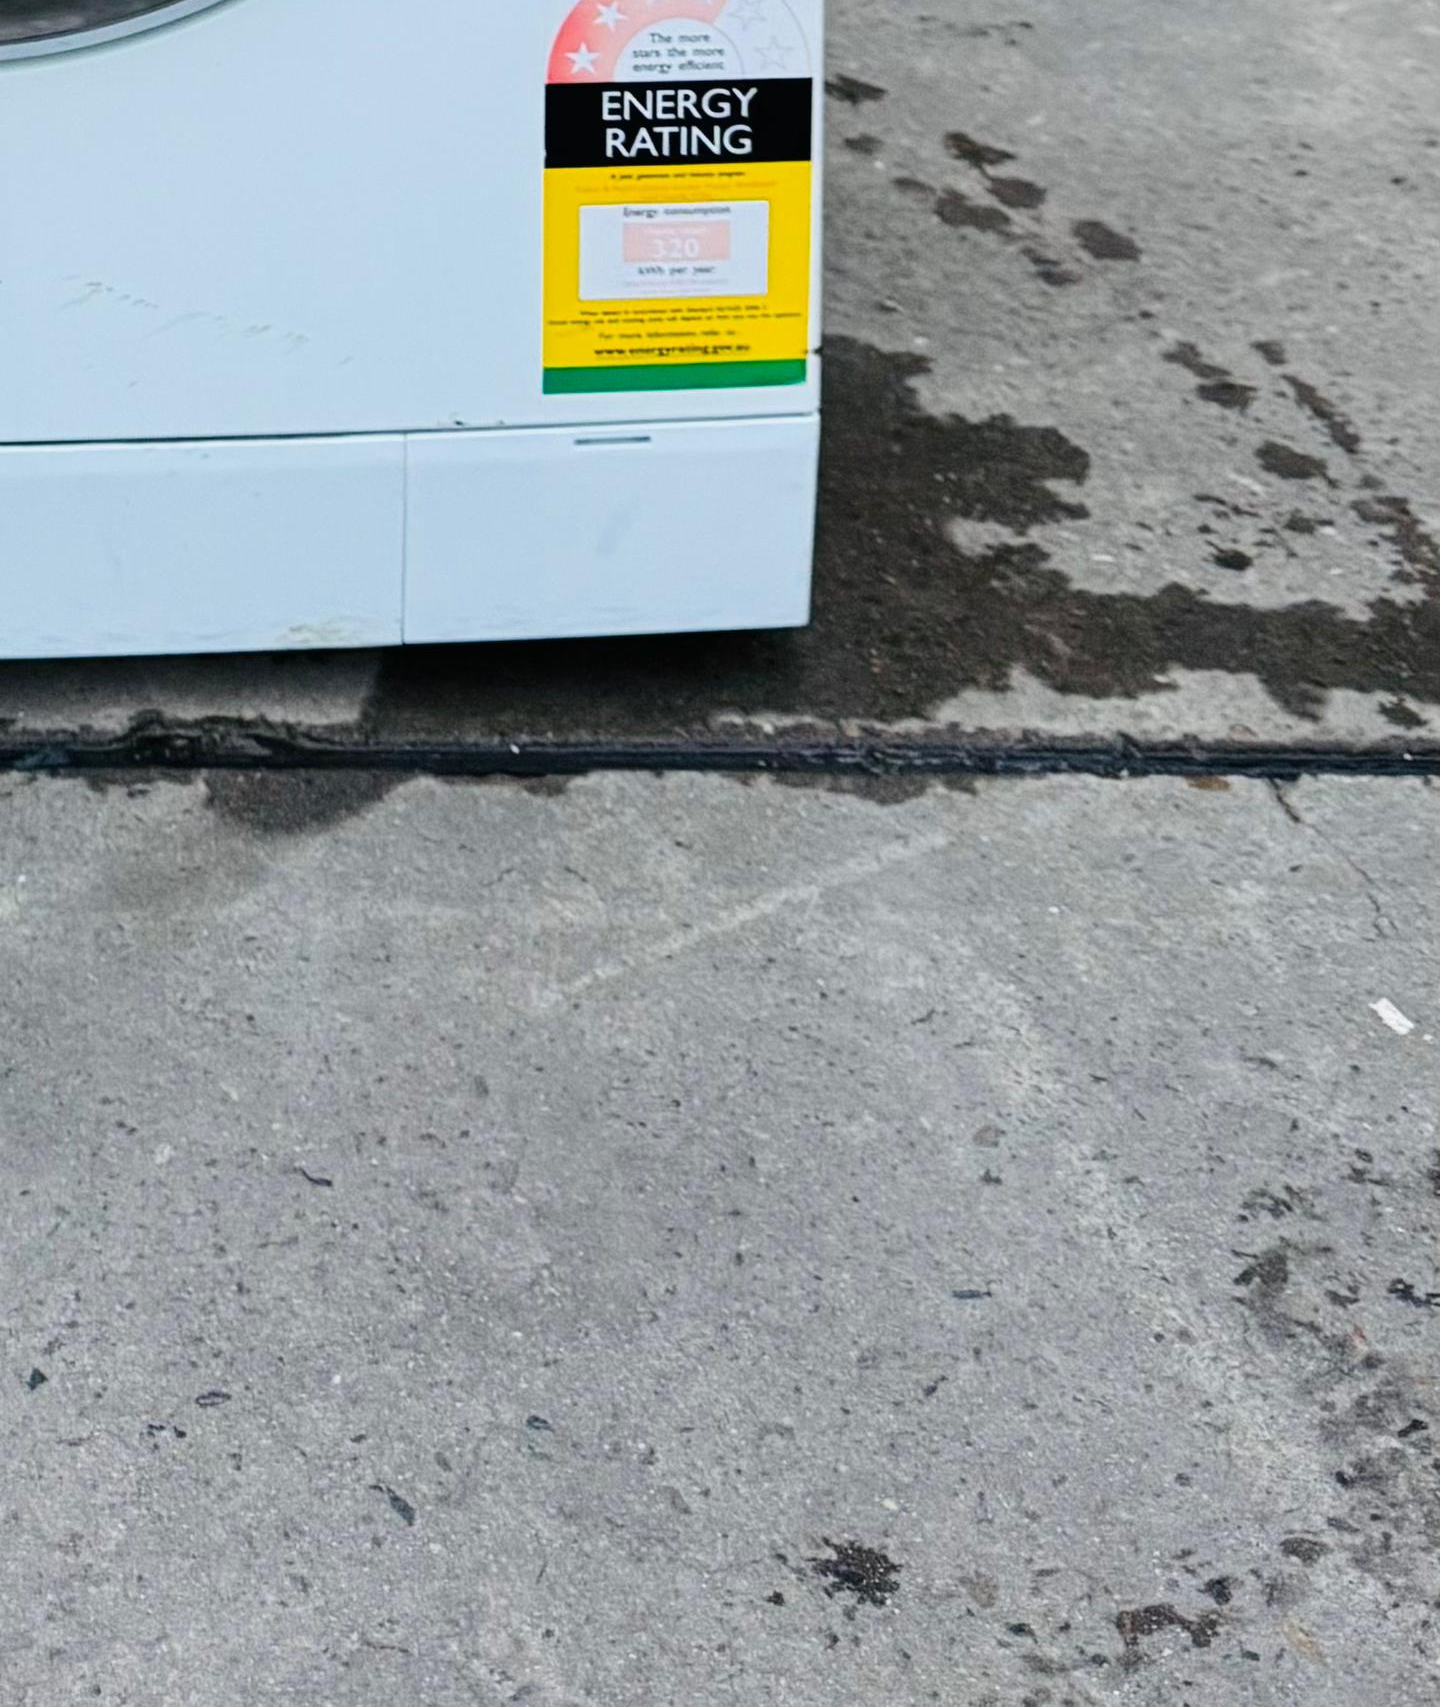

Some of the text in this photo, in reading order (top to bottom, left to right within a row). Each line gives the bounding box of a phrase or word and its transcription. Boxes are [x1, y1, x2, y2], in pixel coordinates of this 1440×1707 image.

[650, 32, 711, 43] The more
[667, 46, 687, 57] the
[692, 47, 725, 57] more
[633, 62, 672, 74] energy
[602, 87, 758, 121] ENERGY
[605, 124, 753, 158] RATING
